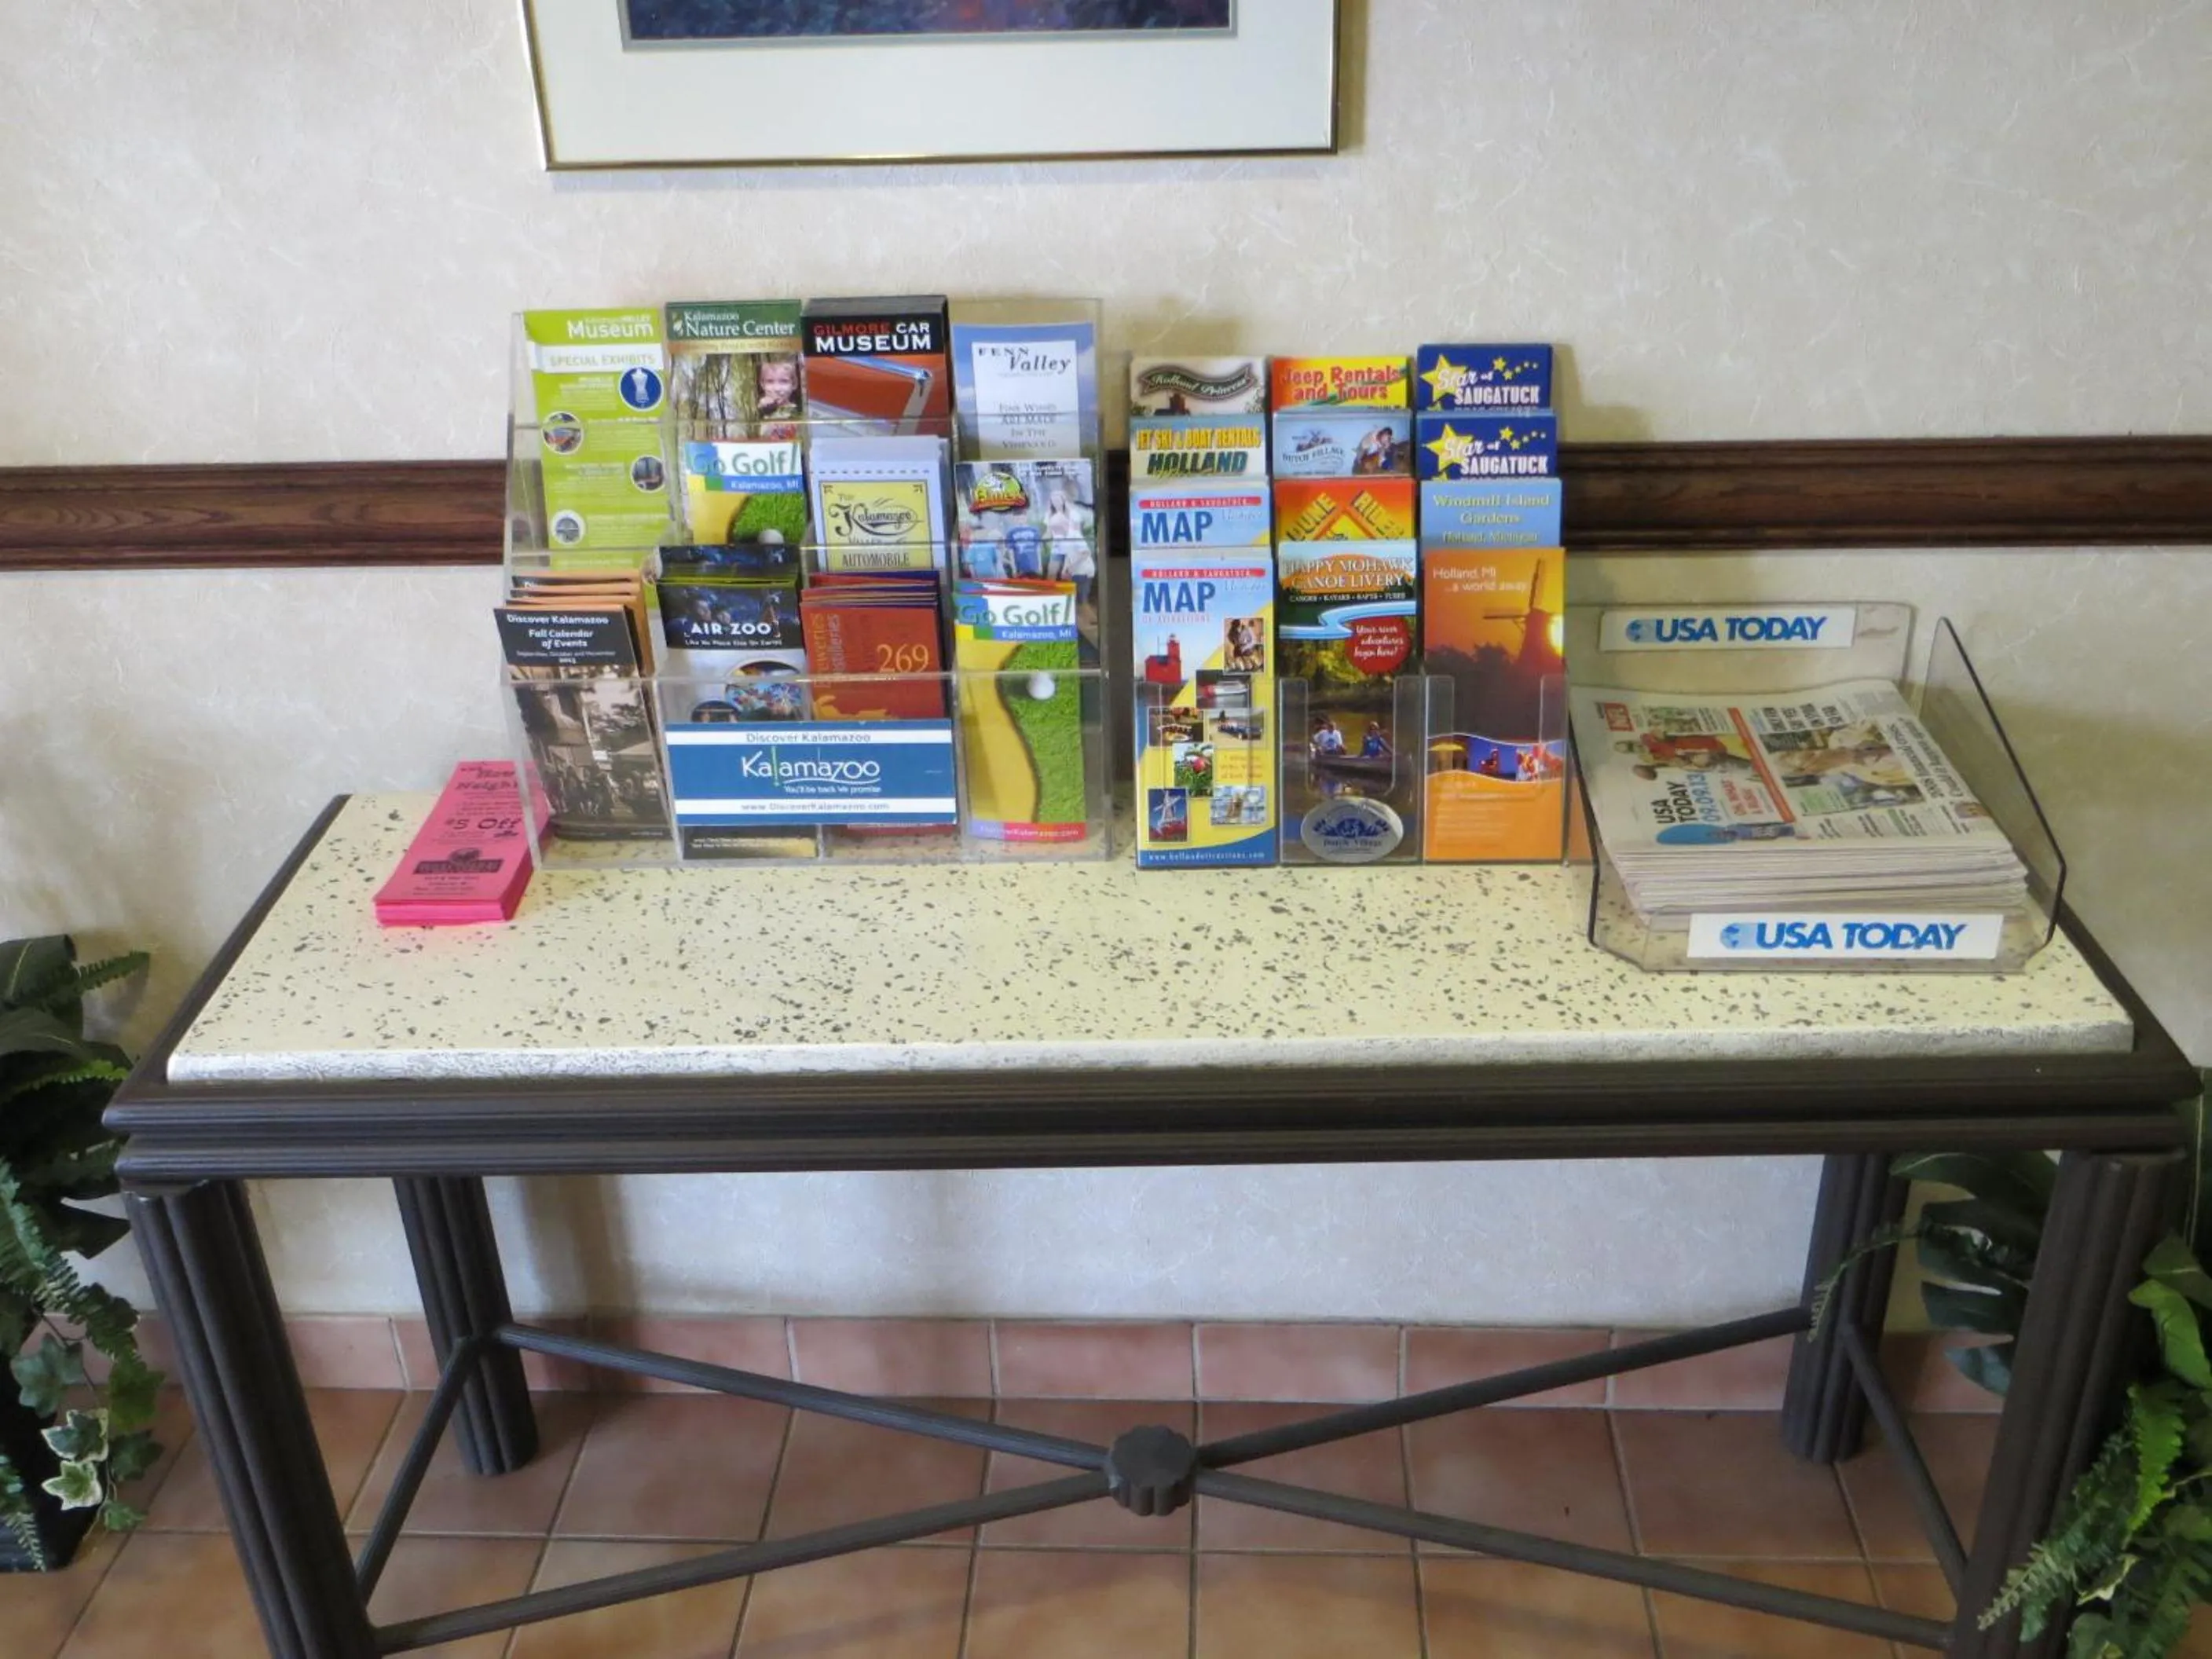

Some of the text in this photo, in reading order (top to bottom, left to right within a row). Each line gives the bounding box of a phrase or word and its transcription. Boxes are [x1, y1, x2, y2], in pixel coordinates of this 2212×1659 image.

[566, 320, 654, 339] Museum
[686, 320, 796, 336] Nature Center
[814, 322, 930, 335] GILMORE CAR
[815, 335, 932, 353] MUSEUM
[979, 347, 1029, 356] FENN
[551, 354, 655, 367] SPECIAL EXHIBITS
[1010, 355, 1071, 375] Valley
[1281, 365, 1400, 386] Jeep Rentals
[1437, 370, 1478, 390] Star
[1294, 383, 1387, 400] and Tours
[1455, 386, 1540, 405] SAUGATUCK
[1154, 429, 1172, 450] SKI
[1184, 428, 1213, 449] BOAT
[1214, 427, 1262, 449] RENTALS
[694, 443, 798, 474] Go Golf!
[1444, 440, 1485, 458] Star
[1147, 452, 1249, 475] HOLLAND
[1461, 455, 1548, 474] SAUGATUCK
[1506, 494, 1551, 507] Island
[1141, 511, 1214, 544] MAP
[841, 553, 910, 566] AUTOMOBILE
[1285, 557, 1414, 573] HAPPY MOHAWK
[1291, 574, 1404, 588] CANOE LIVERY
[1462, 580, 1496, 591] world
[1143, 581, 1216, 613] MAP
[506, 613, 610, 624] Discover Kalamazoo
[961, 594, 1073, 628] Go Golf!
[529, 628, 594, 638] Fall Calendar
[690, 621, 771, 635] AIR ZOO
[1655, 616, 1828, 643] USA TODAY
[876, 643, 930, 674] 269
[746, 733, 871, 742] Discover Kalamazoo
[741, 746, 881, 786] Kalamazoo
[1666, 780, 1700, 823] TODAY
[1687, 773, 1722, 822] 09.09.13
[1651, 798, 1676, 823] USA
[1756, 922, 1968, 950] USA TODAY
